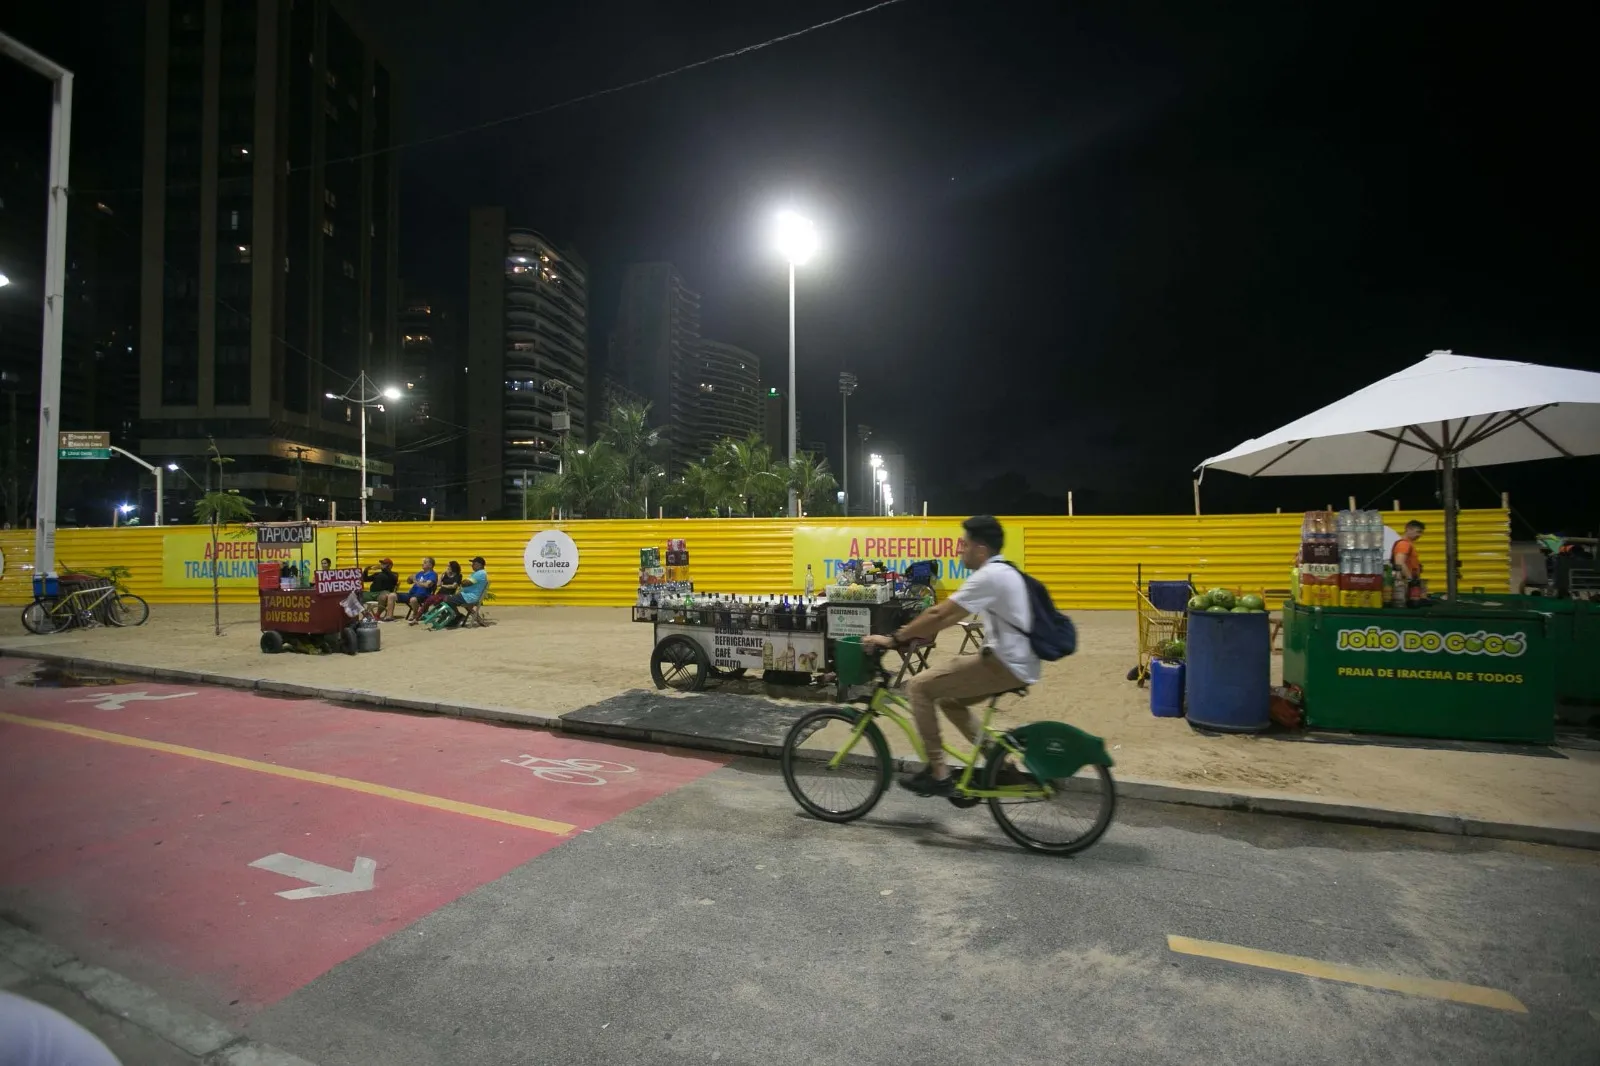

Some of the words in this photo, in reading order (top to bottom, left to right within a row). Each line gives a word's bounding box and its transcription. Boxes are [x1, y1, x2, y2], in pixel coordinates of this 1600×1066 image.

[204, 542, 212, 559] A
[849, 537, 860, 557] A
[865, 537, 965, 558] PREFEITURA
[532, 560, 570, 568] Fortaleza
[1308, 564, 1336, 573] PETRA
[316, 569, 362, 581] TAPIOCAS
[318, 580, 362, 594] DIVERSAS
[264, 595, 311, 609] TAPIOCAS
[265, 611, 310, 623] DIVERSAS
[715, 635, 763, 648] REFRIGERANTE
[1340, 629, 1398, 649] JOÃO
[1403, 632, 1440, 651] DO
[715, 646, 732, 659] CAFÉ
[1338, 667, 1374, 677] PRAIA
[1377, 668, 1394, 678] DE
[1397, 669, 1453, 680] IRACEMA
[1456, 672, 1474, 681] DE
[1477, 673, 1524, 684] TODOS
